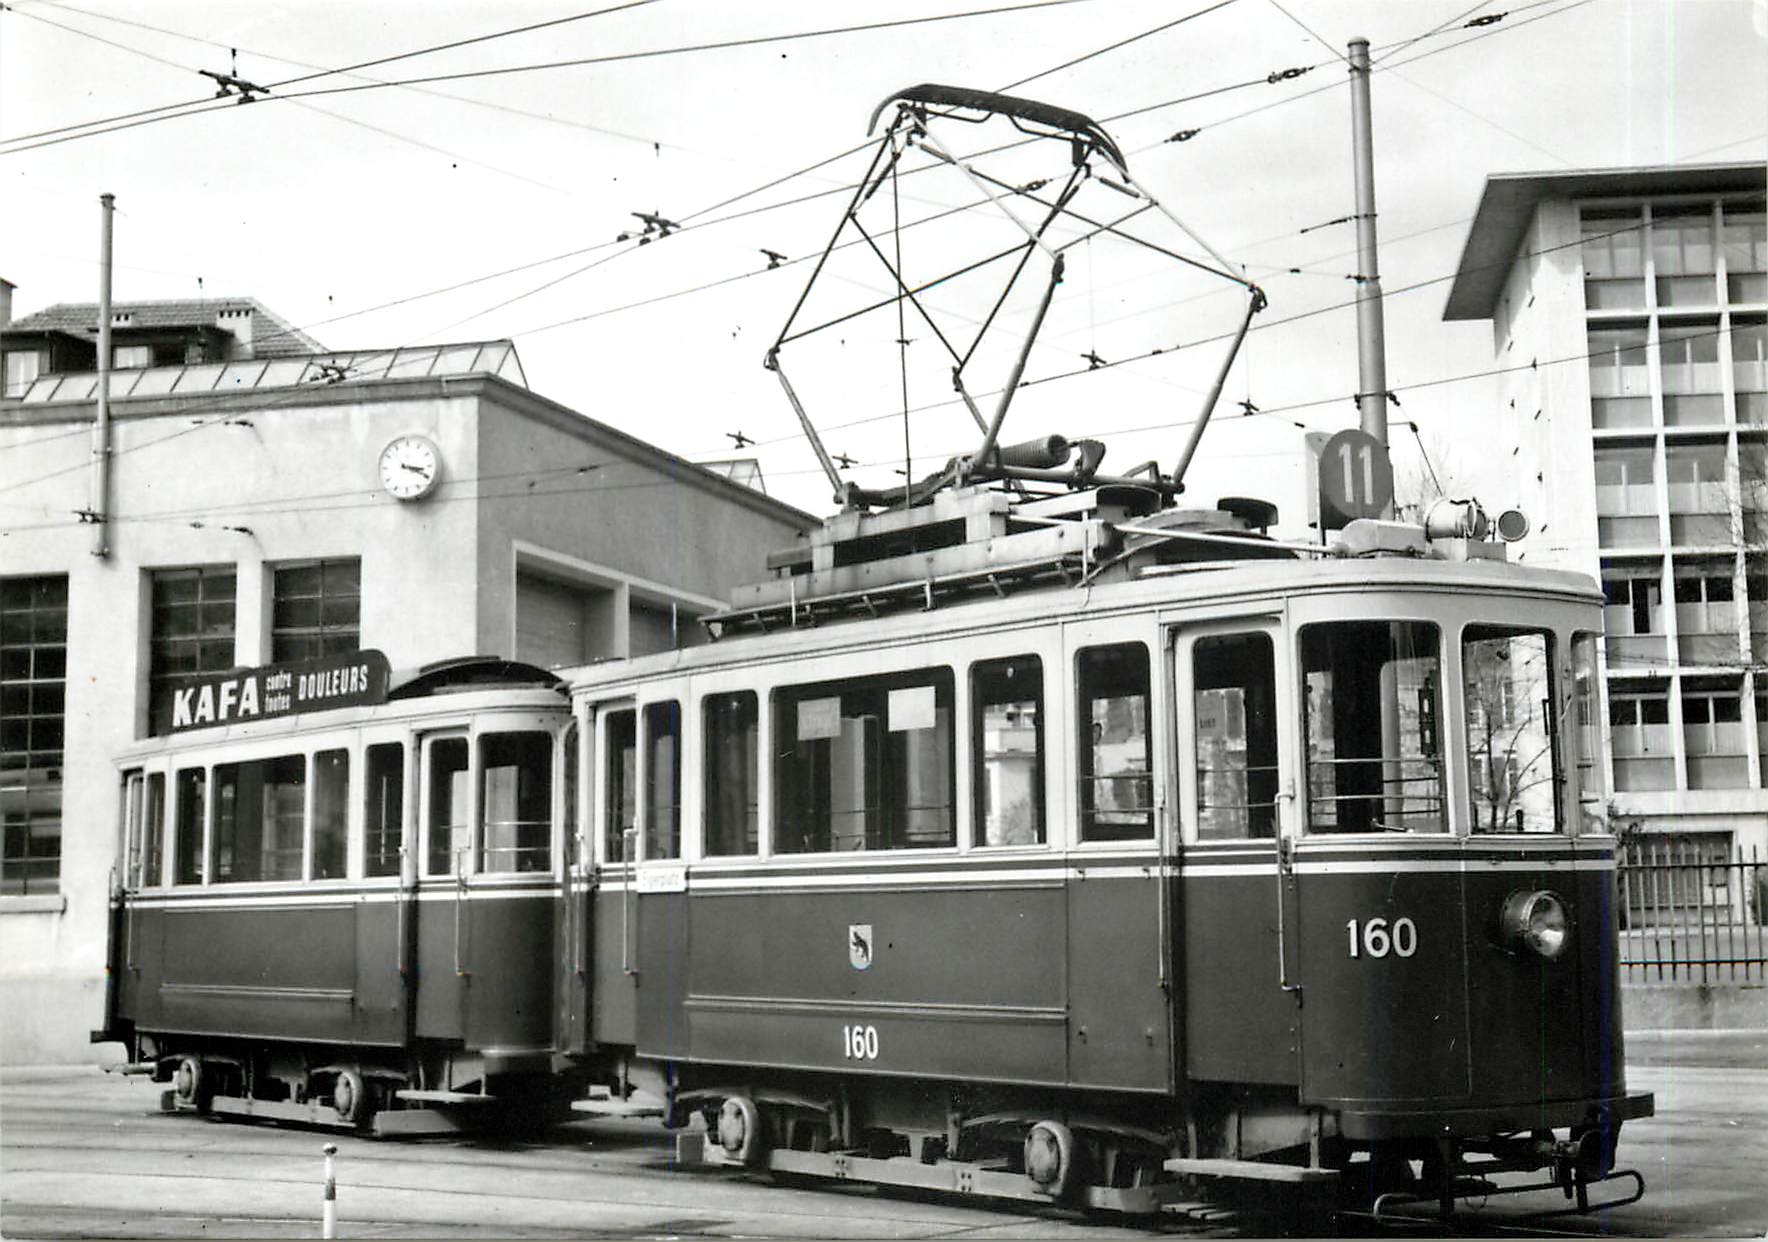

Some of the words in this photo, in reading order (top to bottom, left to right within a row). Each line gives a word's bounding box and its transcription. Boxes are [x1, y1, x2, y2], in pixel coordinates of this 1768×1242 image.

[1338, 443, 1373, 505] 11
[172, 676, 260, 727] KAFA
[298, 664, 369, 701] DOULEURS
[1346, 917, 1417, 958] 160
[844, 1025, 878, 1059] 160
